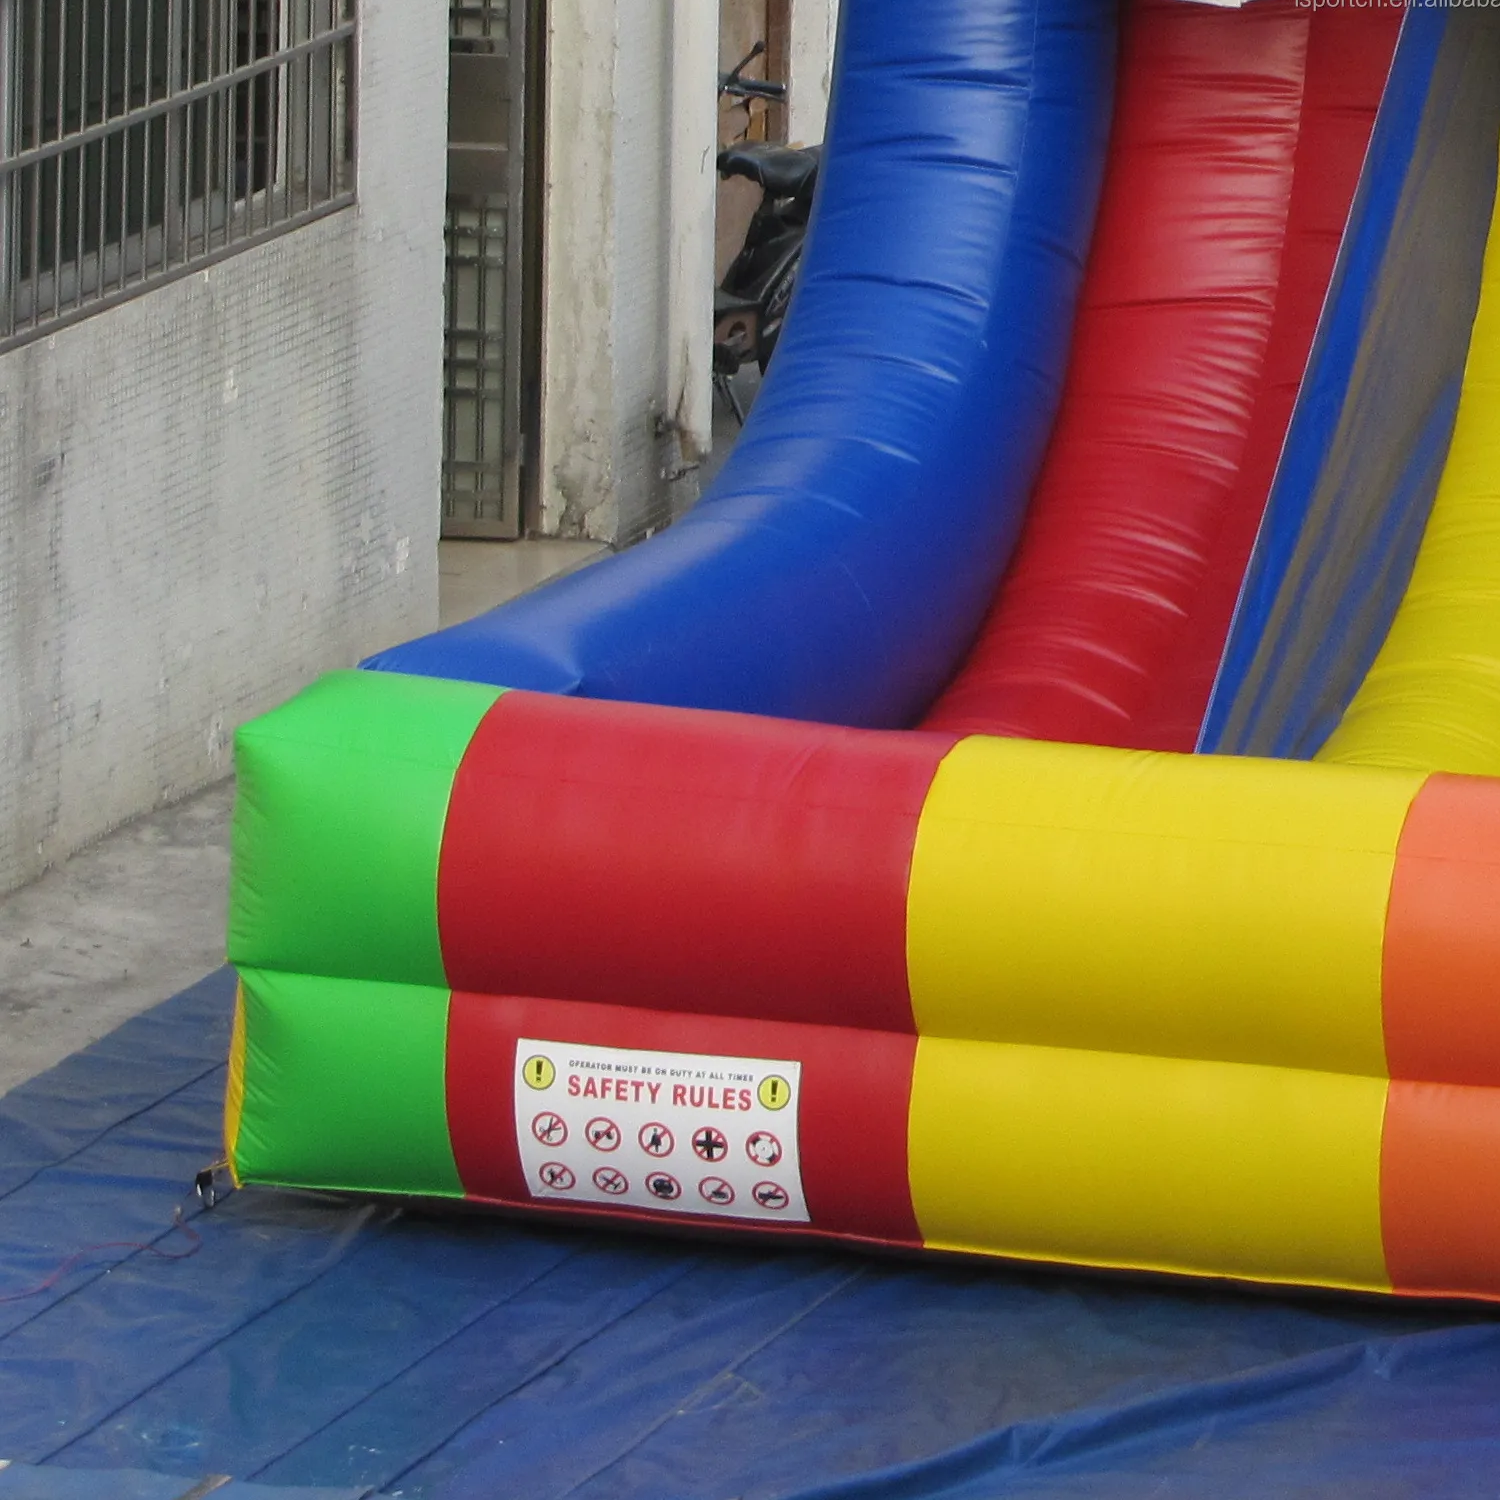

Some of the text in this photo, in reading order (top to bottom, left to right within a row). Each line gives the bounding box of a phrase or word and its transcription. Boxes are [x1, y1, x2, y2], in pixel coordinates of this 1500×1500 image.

[569, 1059, 754, 1082] OPERATOR MUST BE ON DUTY AT ALL TIMES
[567, 1074, 752, 1112] SAFETY RULES
